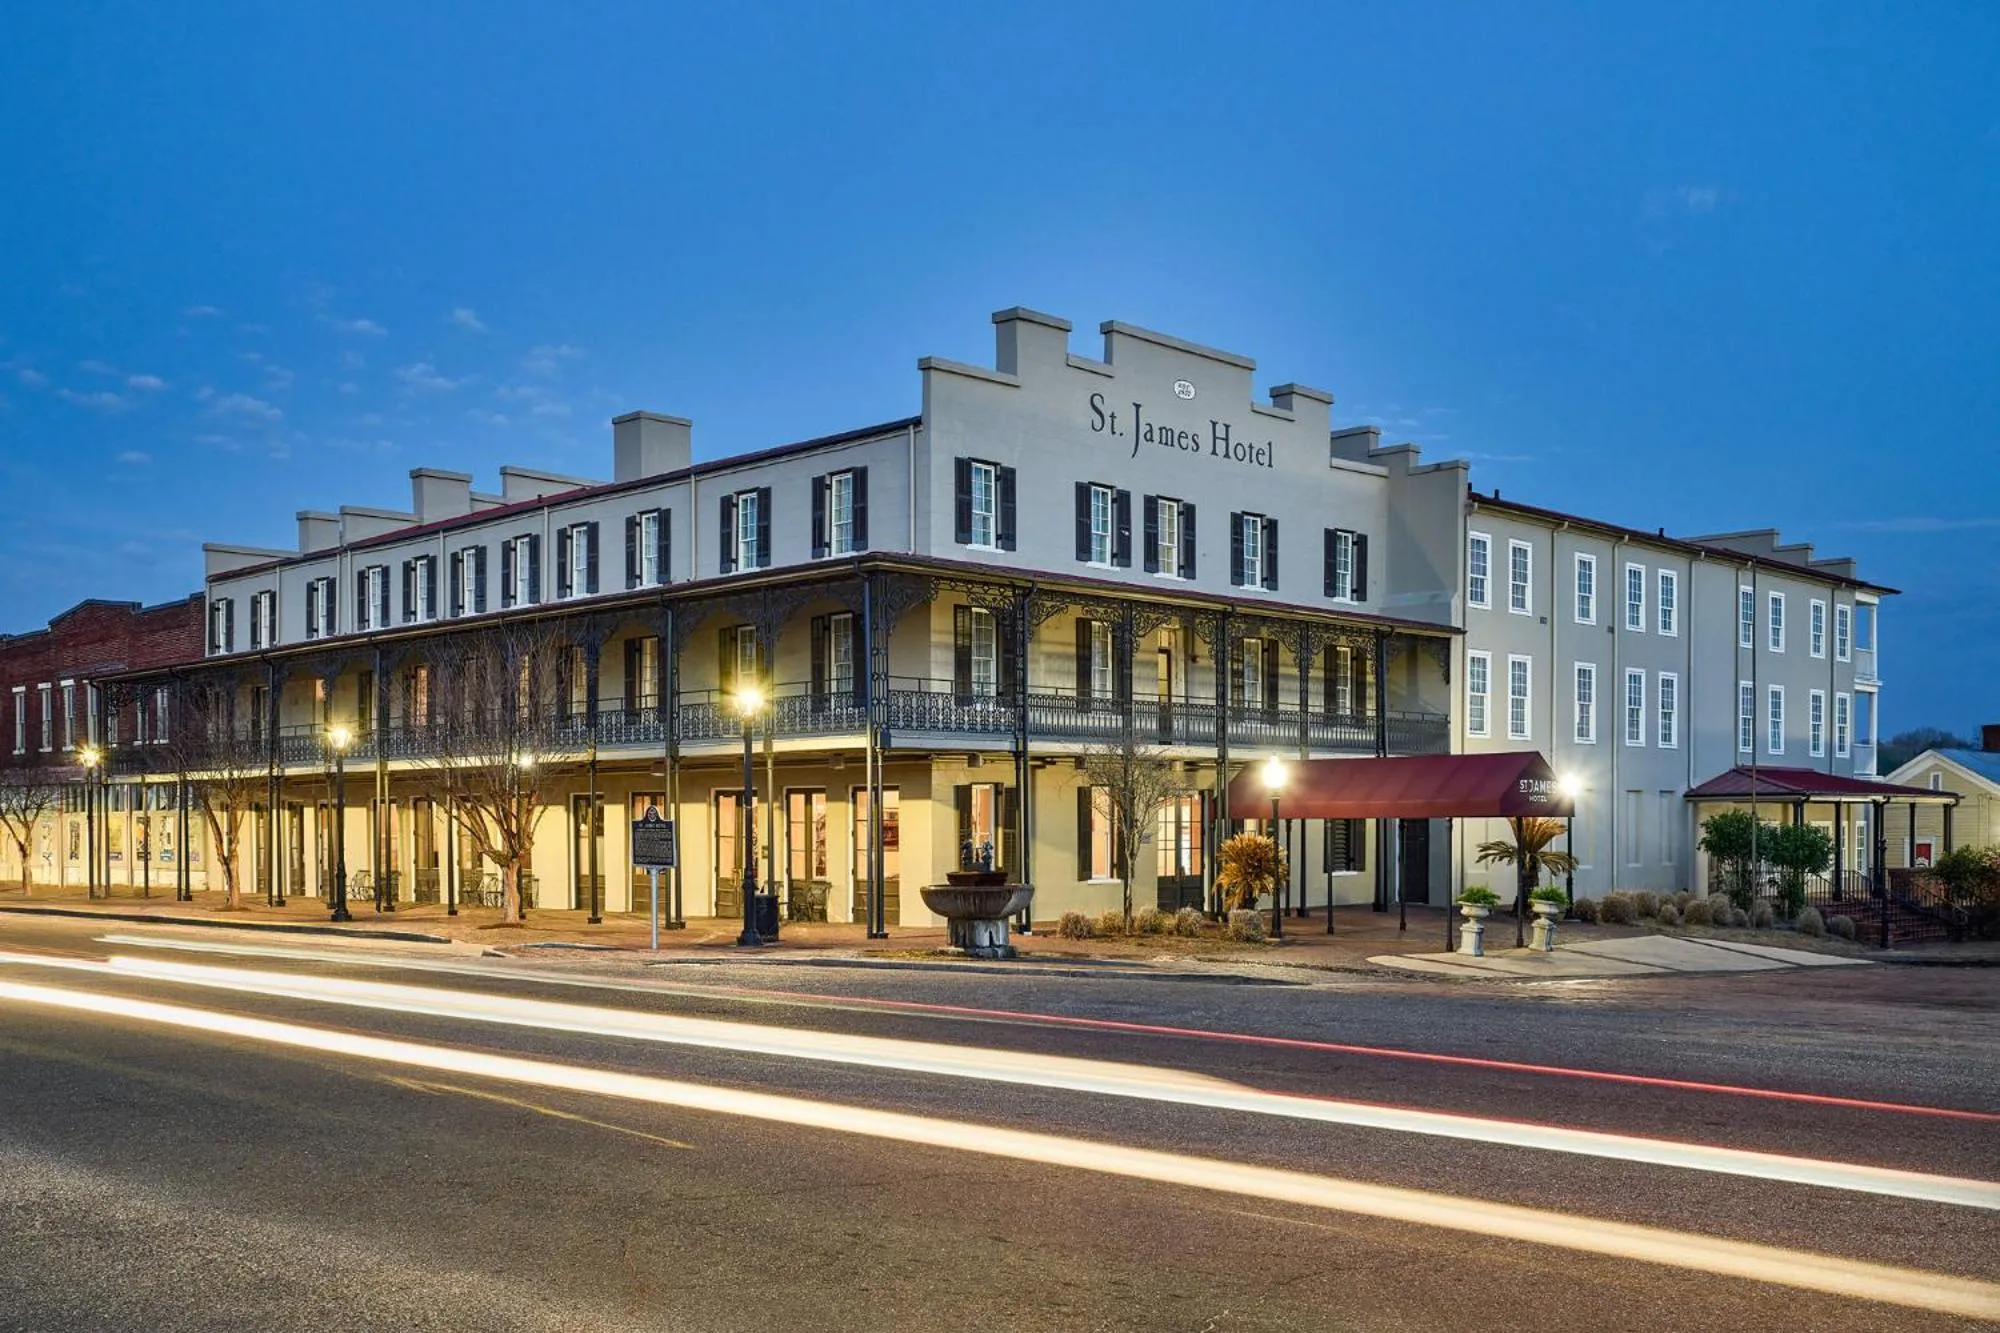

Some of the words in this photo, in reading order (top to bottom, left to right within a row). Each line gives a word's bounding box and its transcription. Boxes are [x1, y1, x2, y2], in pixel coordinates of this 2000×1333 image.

[1089, 392, 1124, 437] St.
[1131, 402, 1200, 459] James
[1209, 419, 1274, 468] Hotel
[1529, 779, 1557, 794] JAMES
